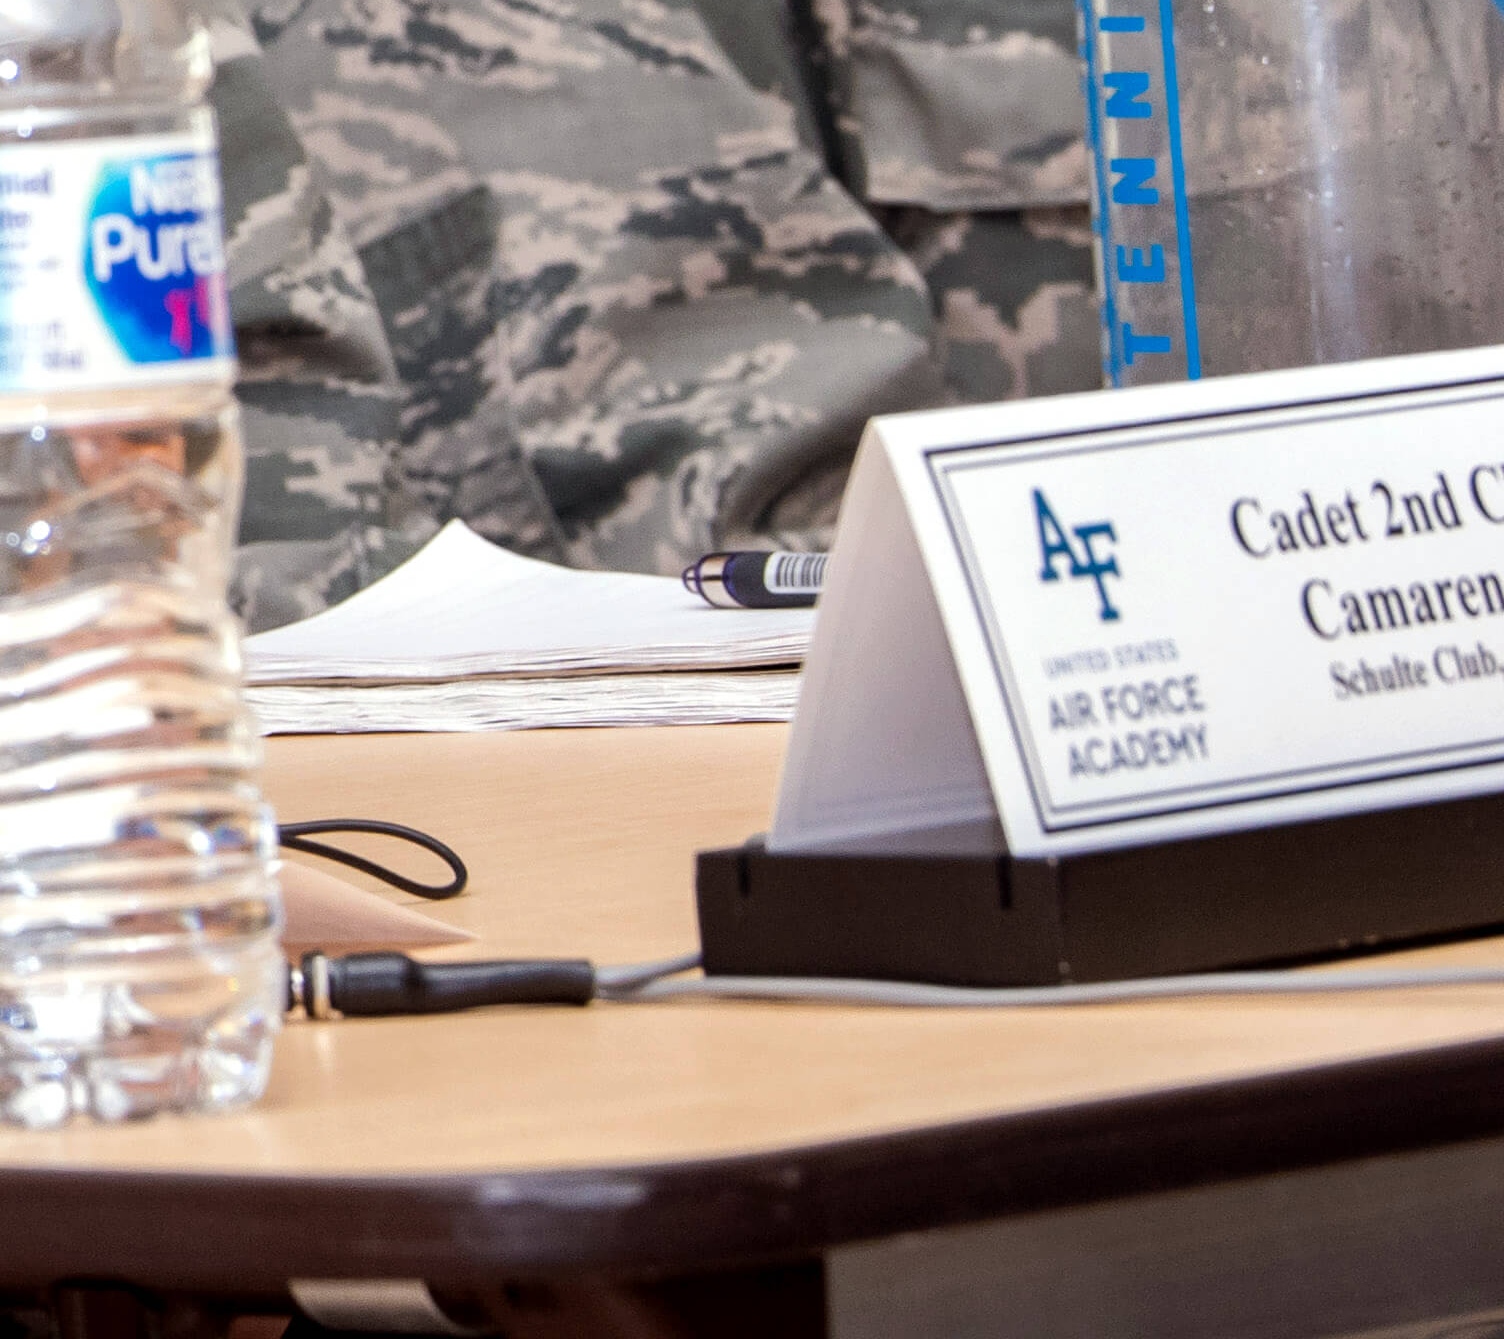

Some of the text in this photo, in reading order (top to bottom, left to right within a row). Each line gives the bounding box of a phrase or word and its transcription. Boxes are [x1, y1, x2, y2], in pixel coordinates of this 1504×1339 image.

[1230, 463, 1504, 559] Cadet 2nd C
[1032, 485, 1122, 622] AF
[1300, 570, 1504, 642] Camaren
[1049, 674, 1207, 731] AIR FORCE
[1068, 722, 1210, 780] ACADEMY
